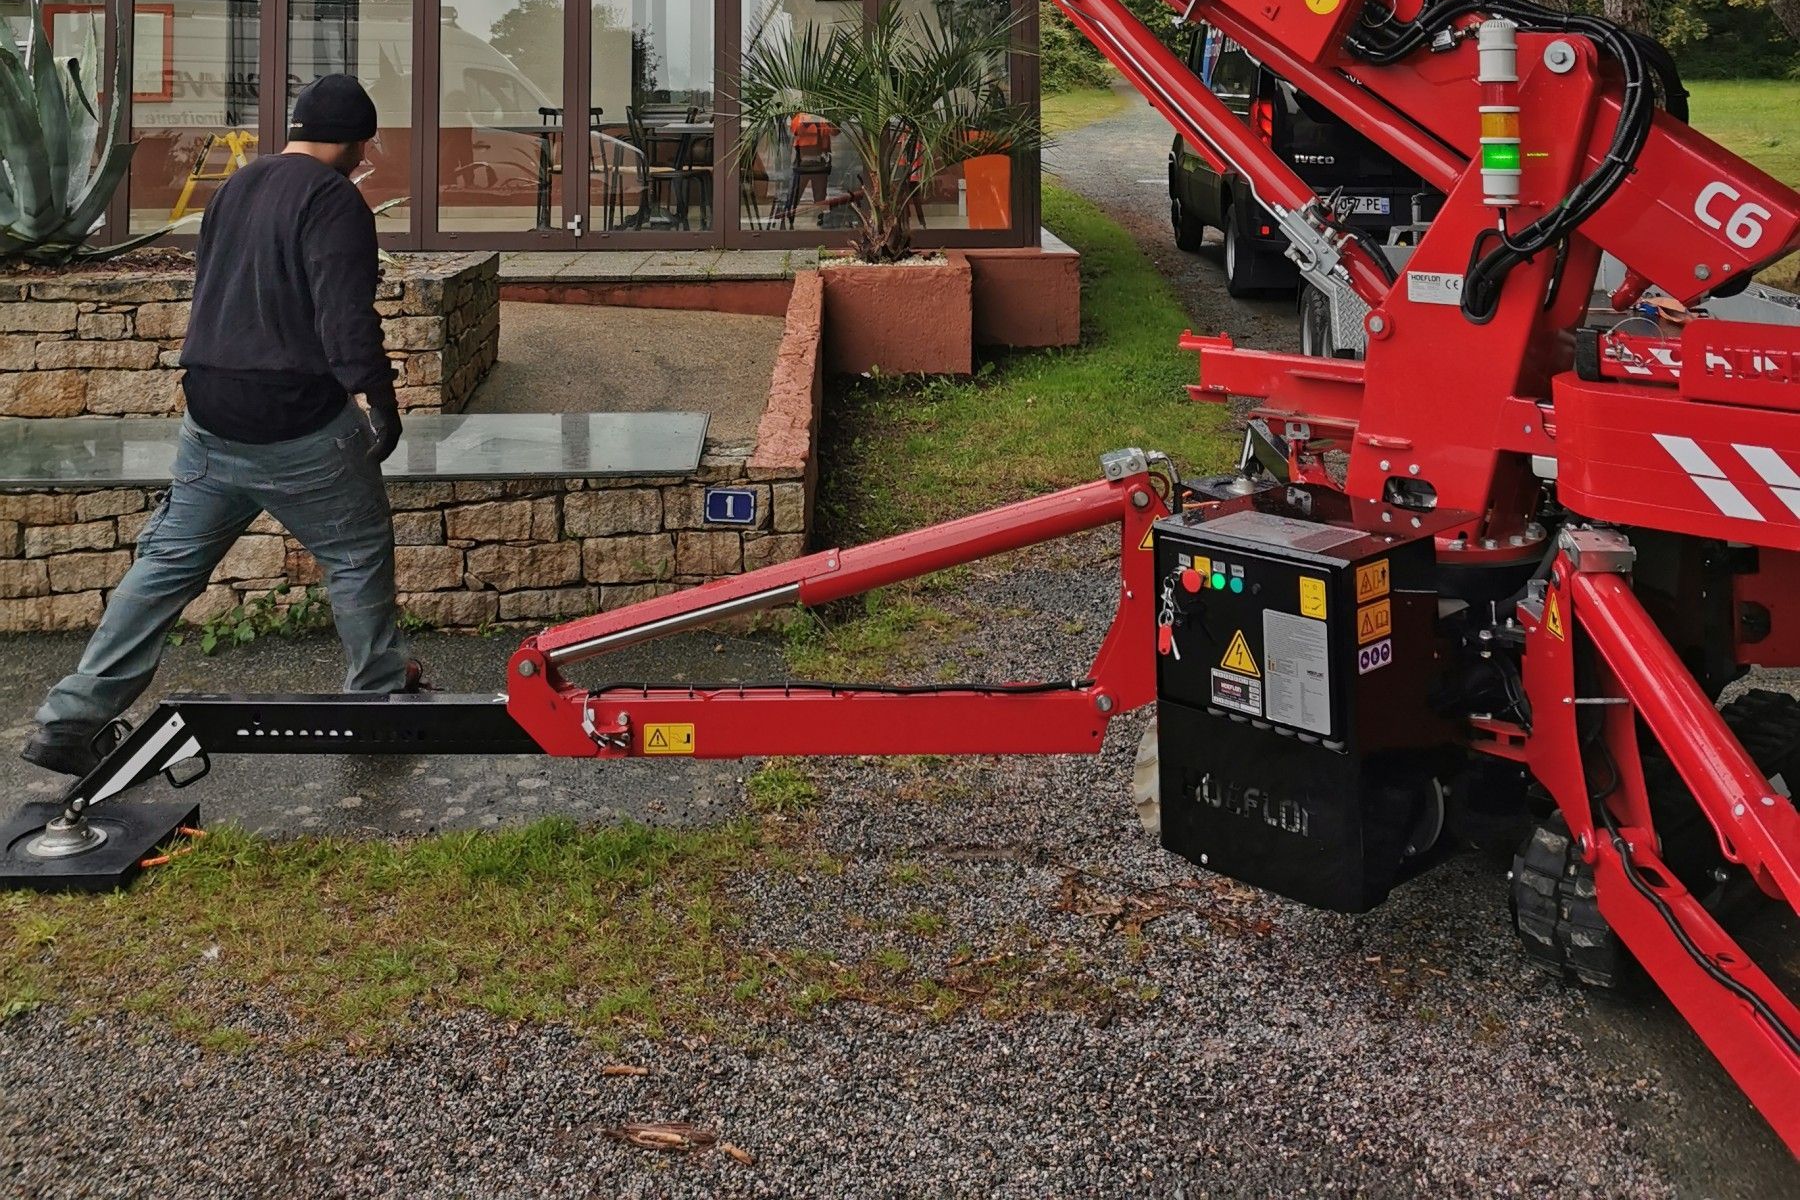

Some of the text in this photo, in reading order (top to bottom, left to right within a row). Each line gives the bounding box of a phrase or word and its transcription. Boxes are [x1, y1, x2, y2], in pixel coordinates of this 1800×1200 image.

[1294, 154, 1335, 165] IVECO
[1694, 181, 1772, 249] C6
[1411, 274, 1441, 282] HOEFLON
[725, 495, 735, 518] 1
